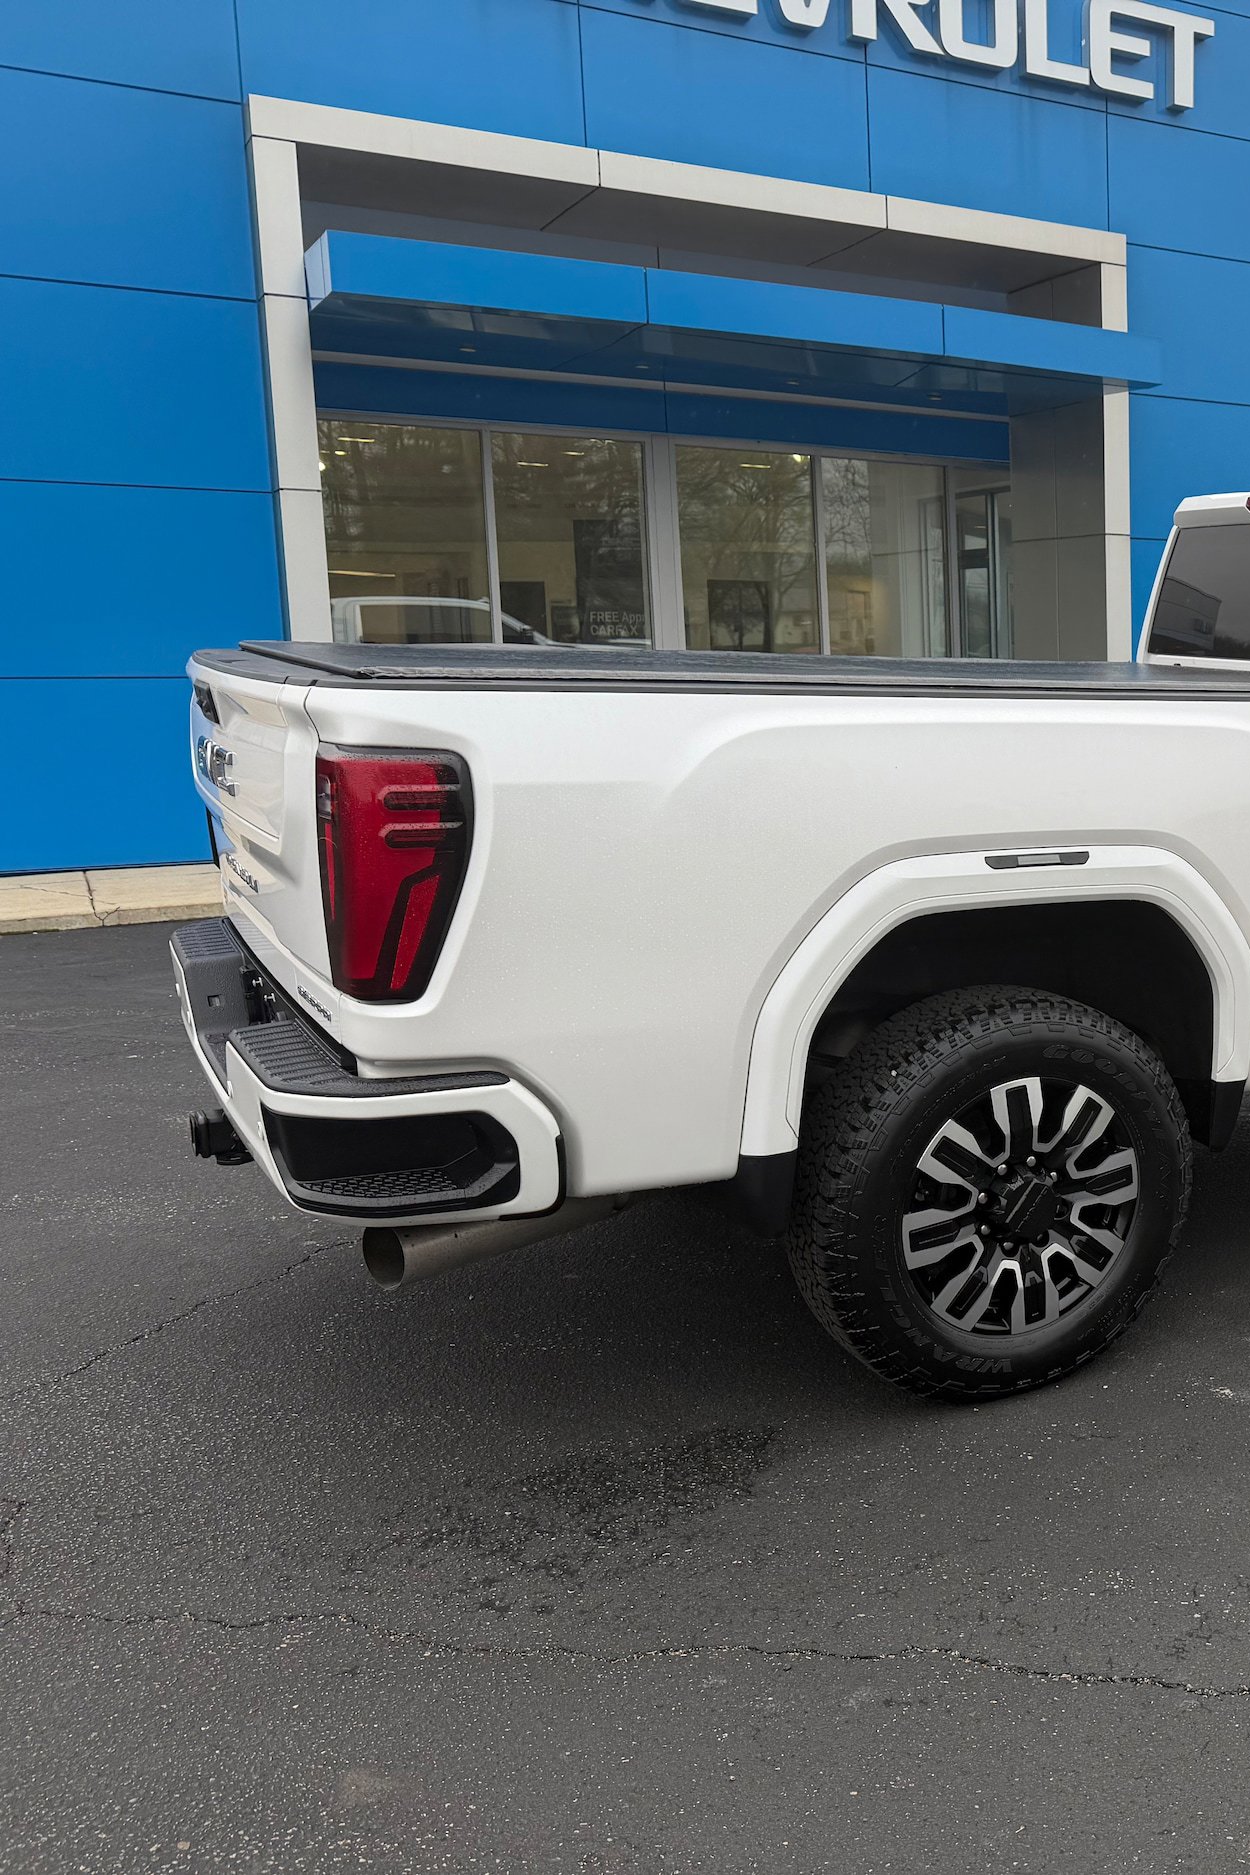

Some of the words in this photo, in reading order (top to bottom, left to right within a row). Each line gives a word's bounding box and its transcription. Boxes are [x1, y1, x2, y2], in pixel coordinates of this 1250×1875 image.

[677, 0, 1214, 113] OLET
[589, 611, 620, 623] FREE
[590, 624, 640, 636] CARFAX
